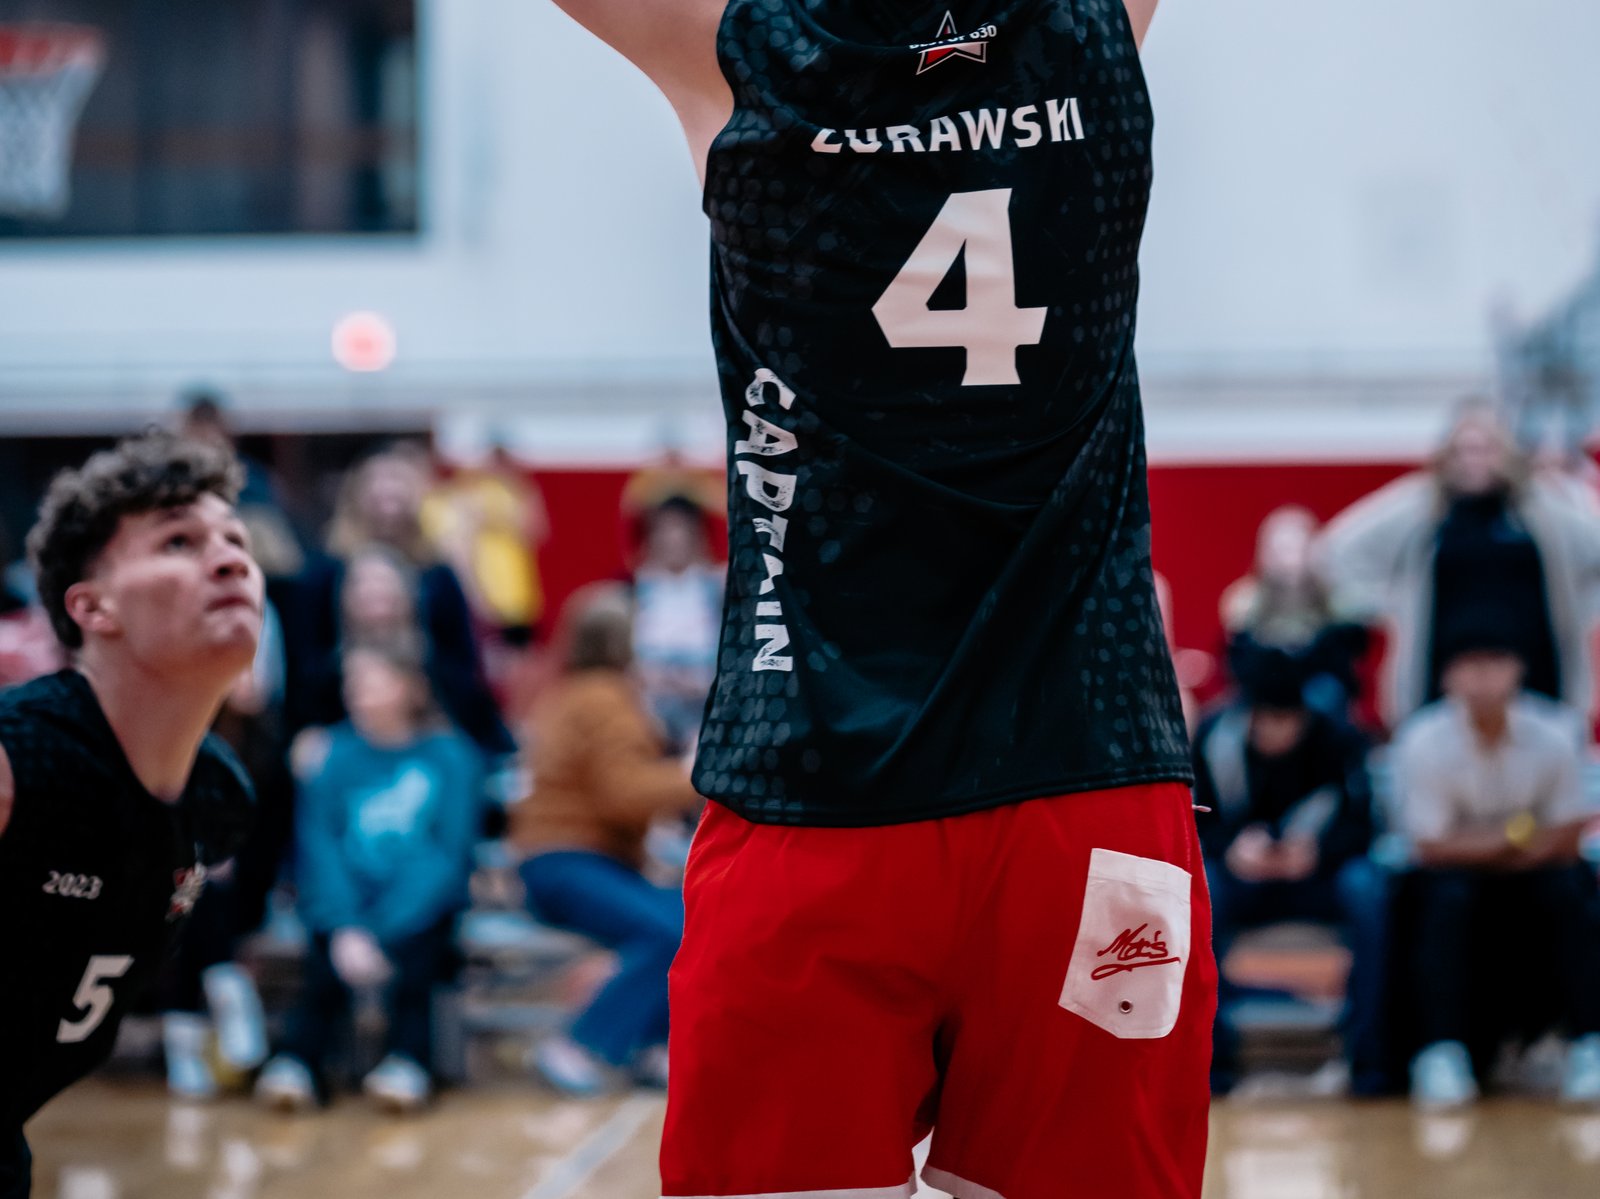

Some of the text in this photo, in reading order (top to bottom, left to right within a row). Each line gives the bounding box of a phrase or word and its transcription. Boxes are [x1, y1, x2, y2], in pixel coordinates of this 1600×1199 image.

[871, 188, 1048, 386] 4
[42, 870, 103, 900] 2023
[56, 954, 134, 1043] 5
